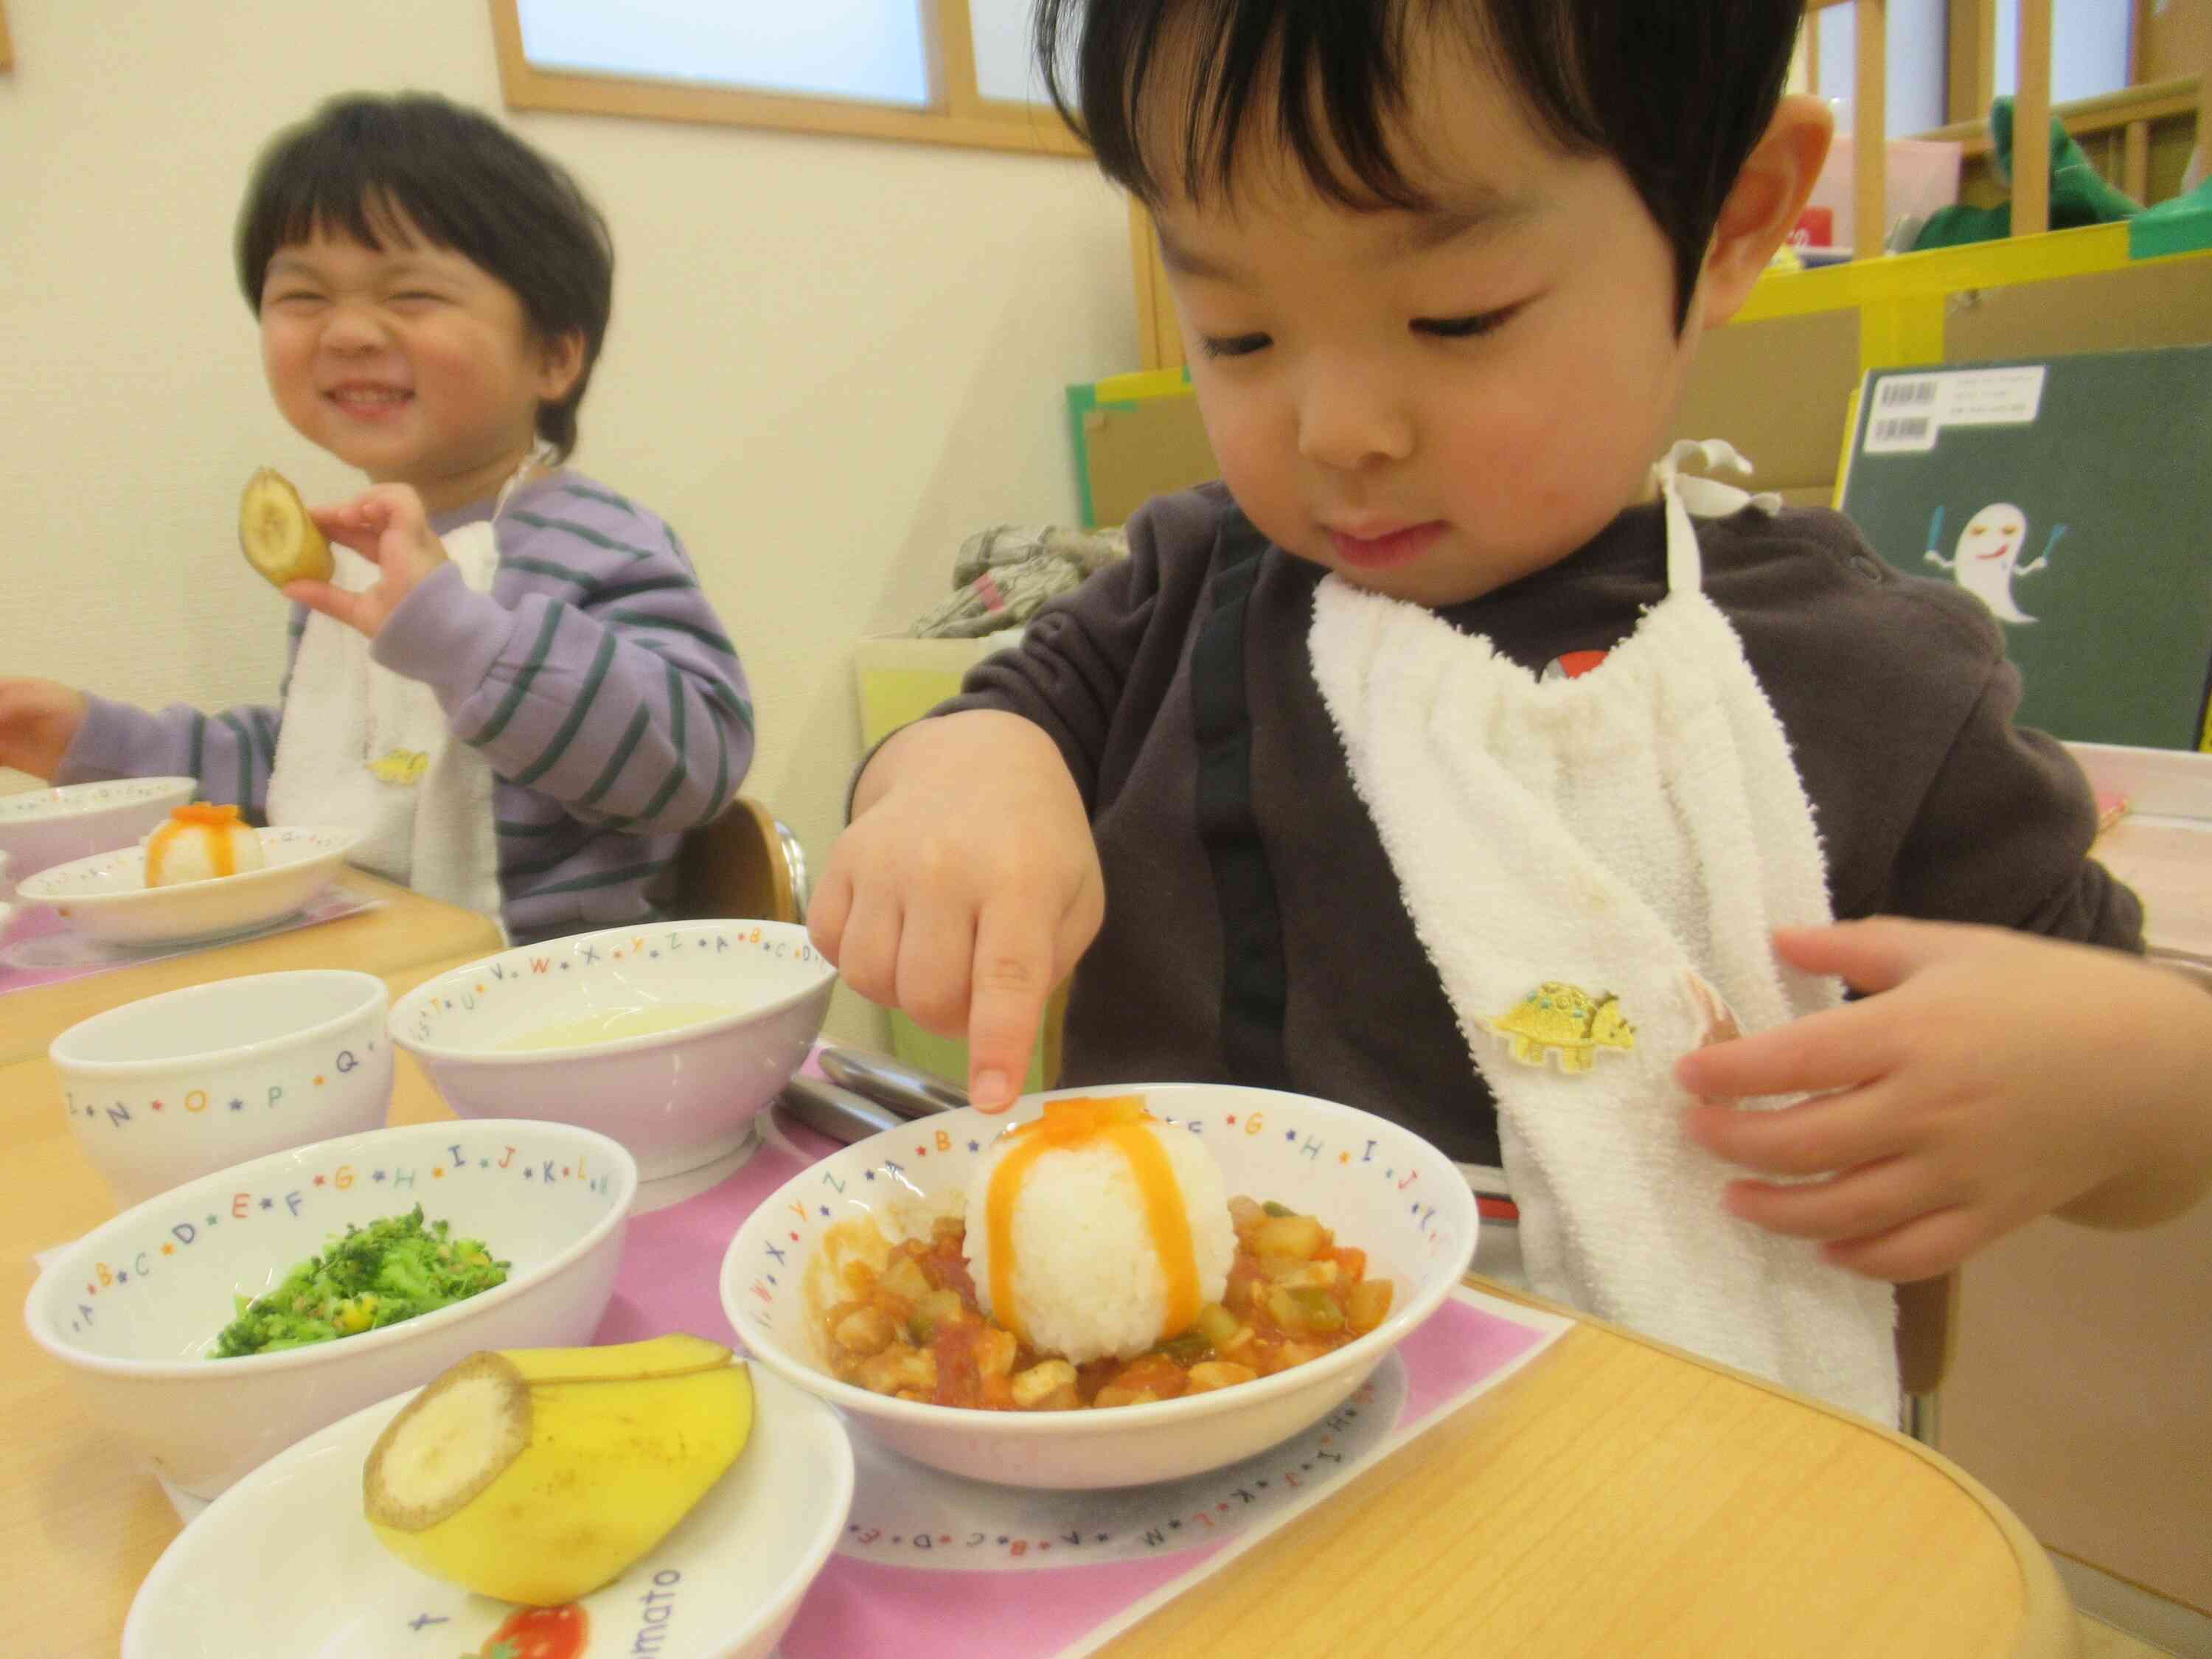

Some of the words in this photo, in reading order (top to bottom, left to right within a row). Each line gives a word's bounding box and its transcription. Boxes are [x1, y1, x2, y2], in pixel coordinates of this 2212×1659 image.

[460, 992, 474, 1009] U
[490, 963, 503, 980] V
[530, 959, 549, 974] W
[582, 945, 601, 967] X
[632, 937, 644, 954] Y
[667, 933, 681, 949] Z
[717, 936, 728, 953] A
[750, 927, 762, 943] B
[775, 942, 787, 958] C
[802, 946, 810, 961] D
[107, 1102, 130, 1127] N
[186, 1090, 205, 1112] O
[268, 1087, 282, 1107] P
[337, 1051, 358, 1072] Q
[1245, 1113, 1262, 1134] G
[1301, 1135, 1325, 1160] H
[1363, 1141, 1377, 1161] I
[1398, 1170, 1417, 1189] J
[79, 1304, 92, 1326] A
[97, 1262, 111, 1286] B
[136, 1253, 149, 1276] C
[173, 1224, 195, 1244] D
[234, 1194, 249, 1218] E
[286, 1192, 301, 1216] F
[336, 1165, 354, 1190] G
[395, 1168, 414, 1189] H
[449, 1145, 465, 1166] I
[498, 1145, 515, 1168] J
[543, 1160, 555, 1183] K
[578, 1157, 587, 1179] L
[765, 1240, 785, 1266] X
[789, 1201, 807, 1221] Y
[823, 1171, 846, 1193] Z
[936, 1131, 951, 1152] B
[1230, 1489, 1254, 1503] K
[914, 1534, 931, 1548] D
[966, 1532, 985, 1547] C
